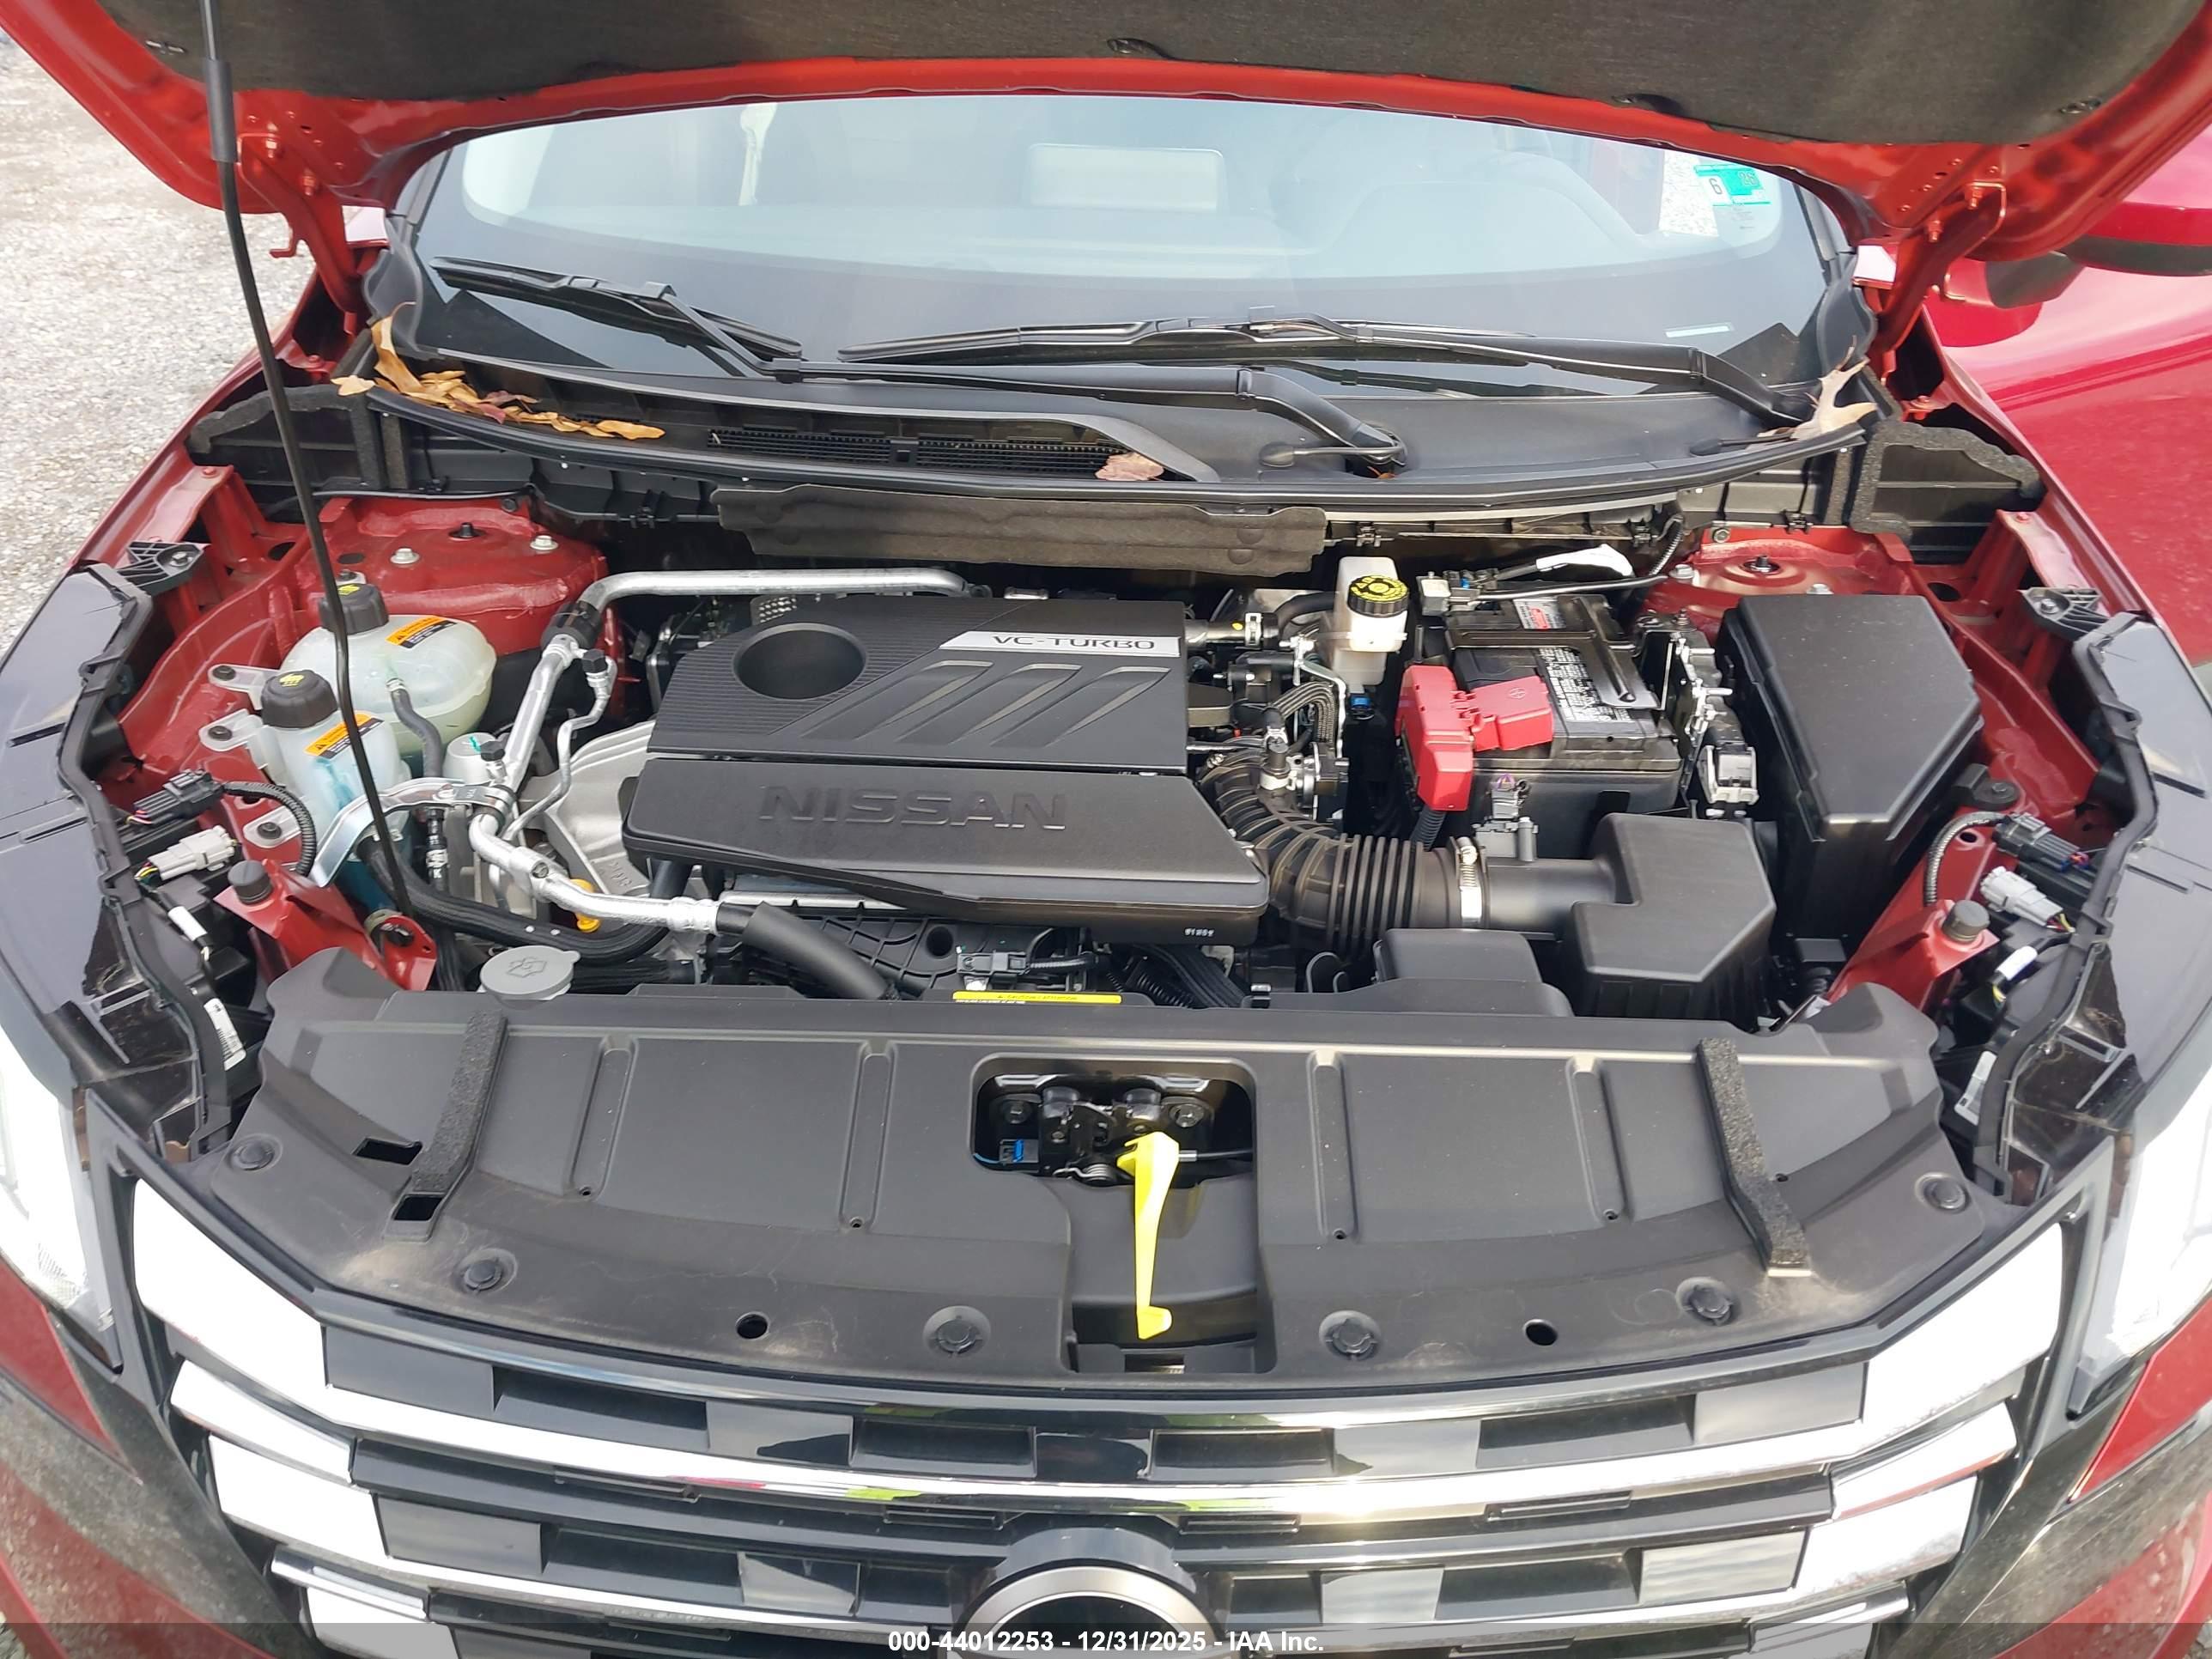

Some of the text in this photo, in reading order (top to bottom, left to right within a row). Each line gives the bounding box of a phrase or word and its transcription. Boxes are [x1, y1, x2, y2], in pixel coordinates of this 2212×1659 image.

[1709, 178, 1723, 195] 6
[993, 635, 1155, 650] VC-TURBO
[758, 785, 1066, 830] NISSAN
